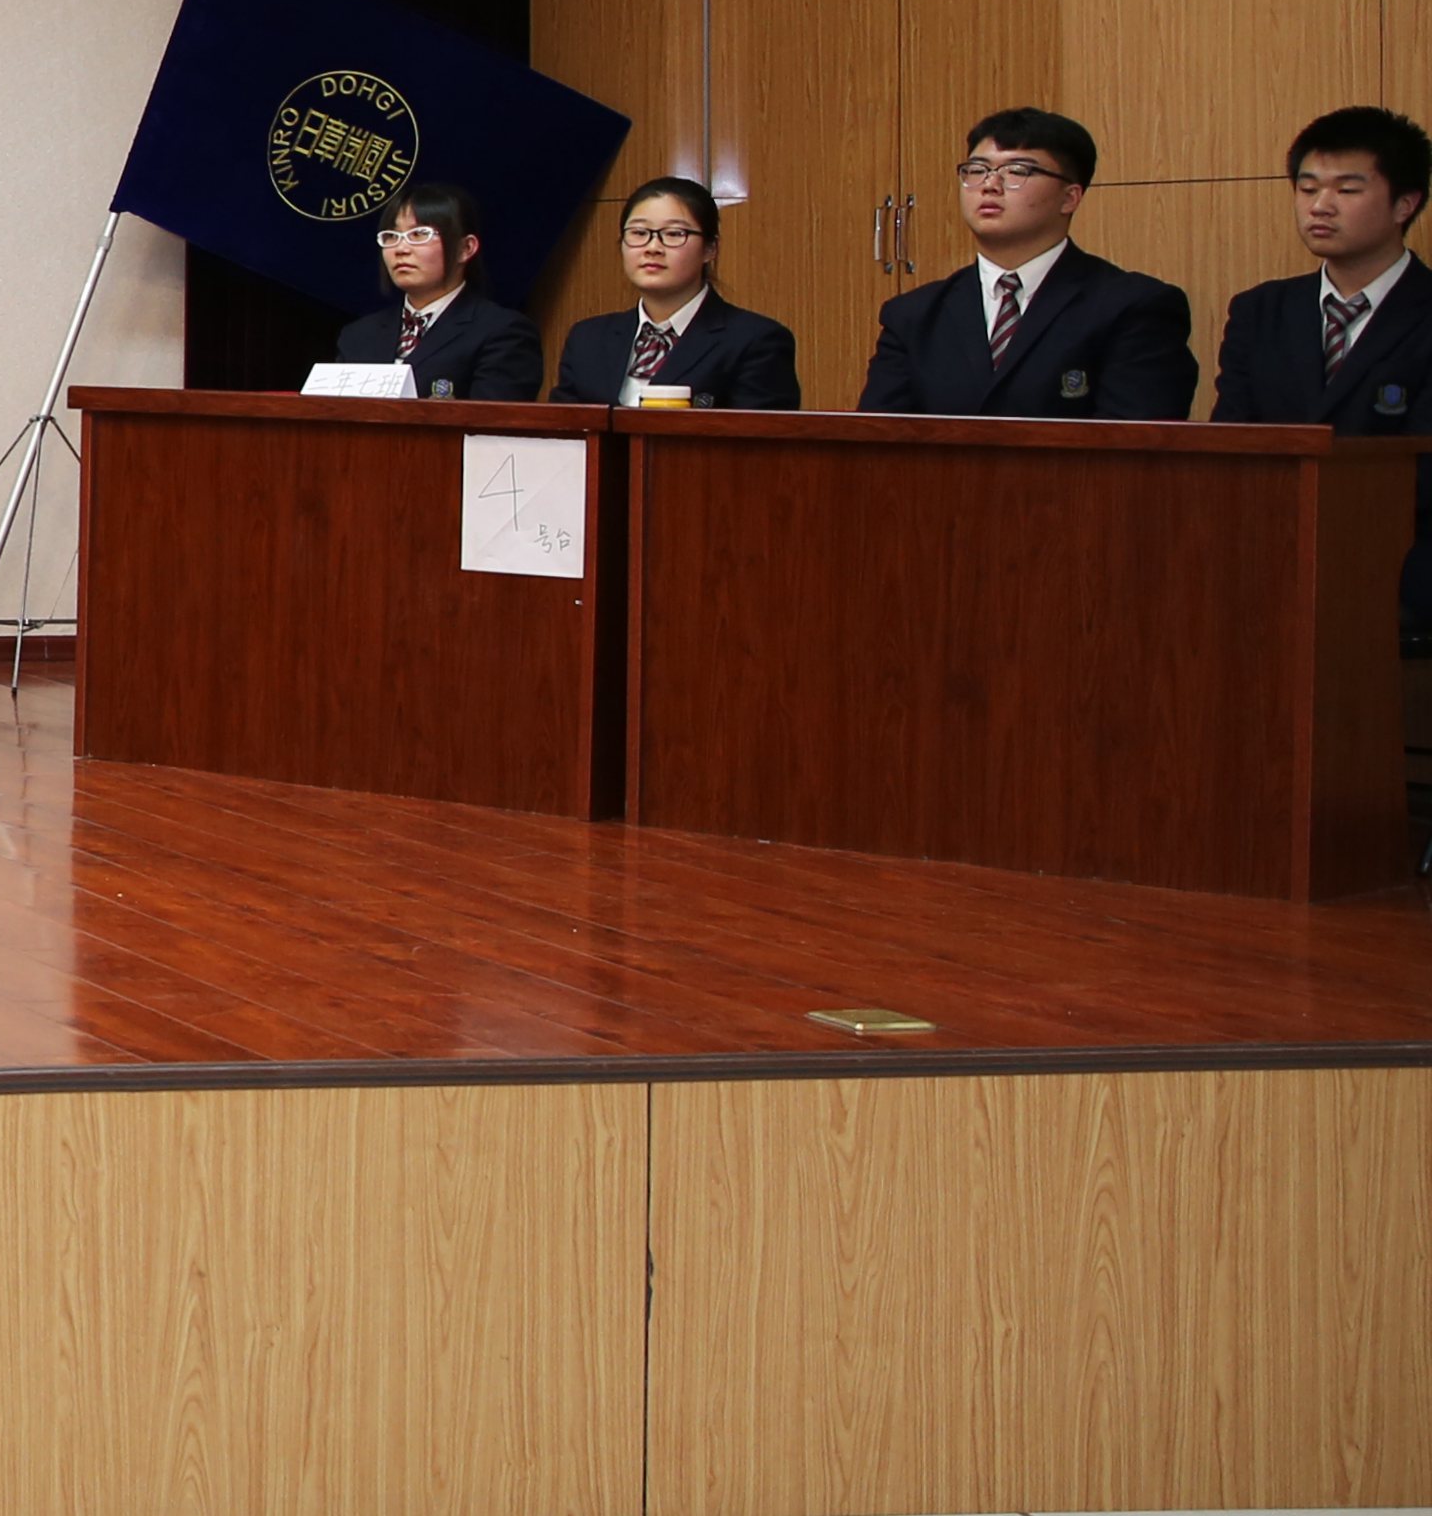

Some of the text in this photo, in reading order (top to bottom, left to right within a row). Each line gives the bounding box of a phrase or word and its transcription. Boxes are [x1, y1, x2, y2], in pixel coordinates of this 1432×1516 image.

[321, 75, 404, 120] DOHGI
[272, 107, 299, 192] KINRO
[321, 150, 410, 217] JITSURI
[308, 369, 403, 396] 二年七班
[478, 453, 524, 531] 4
